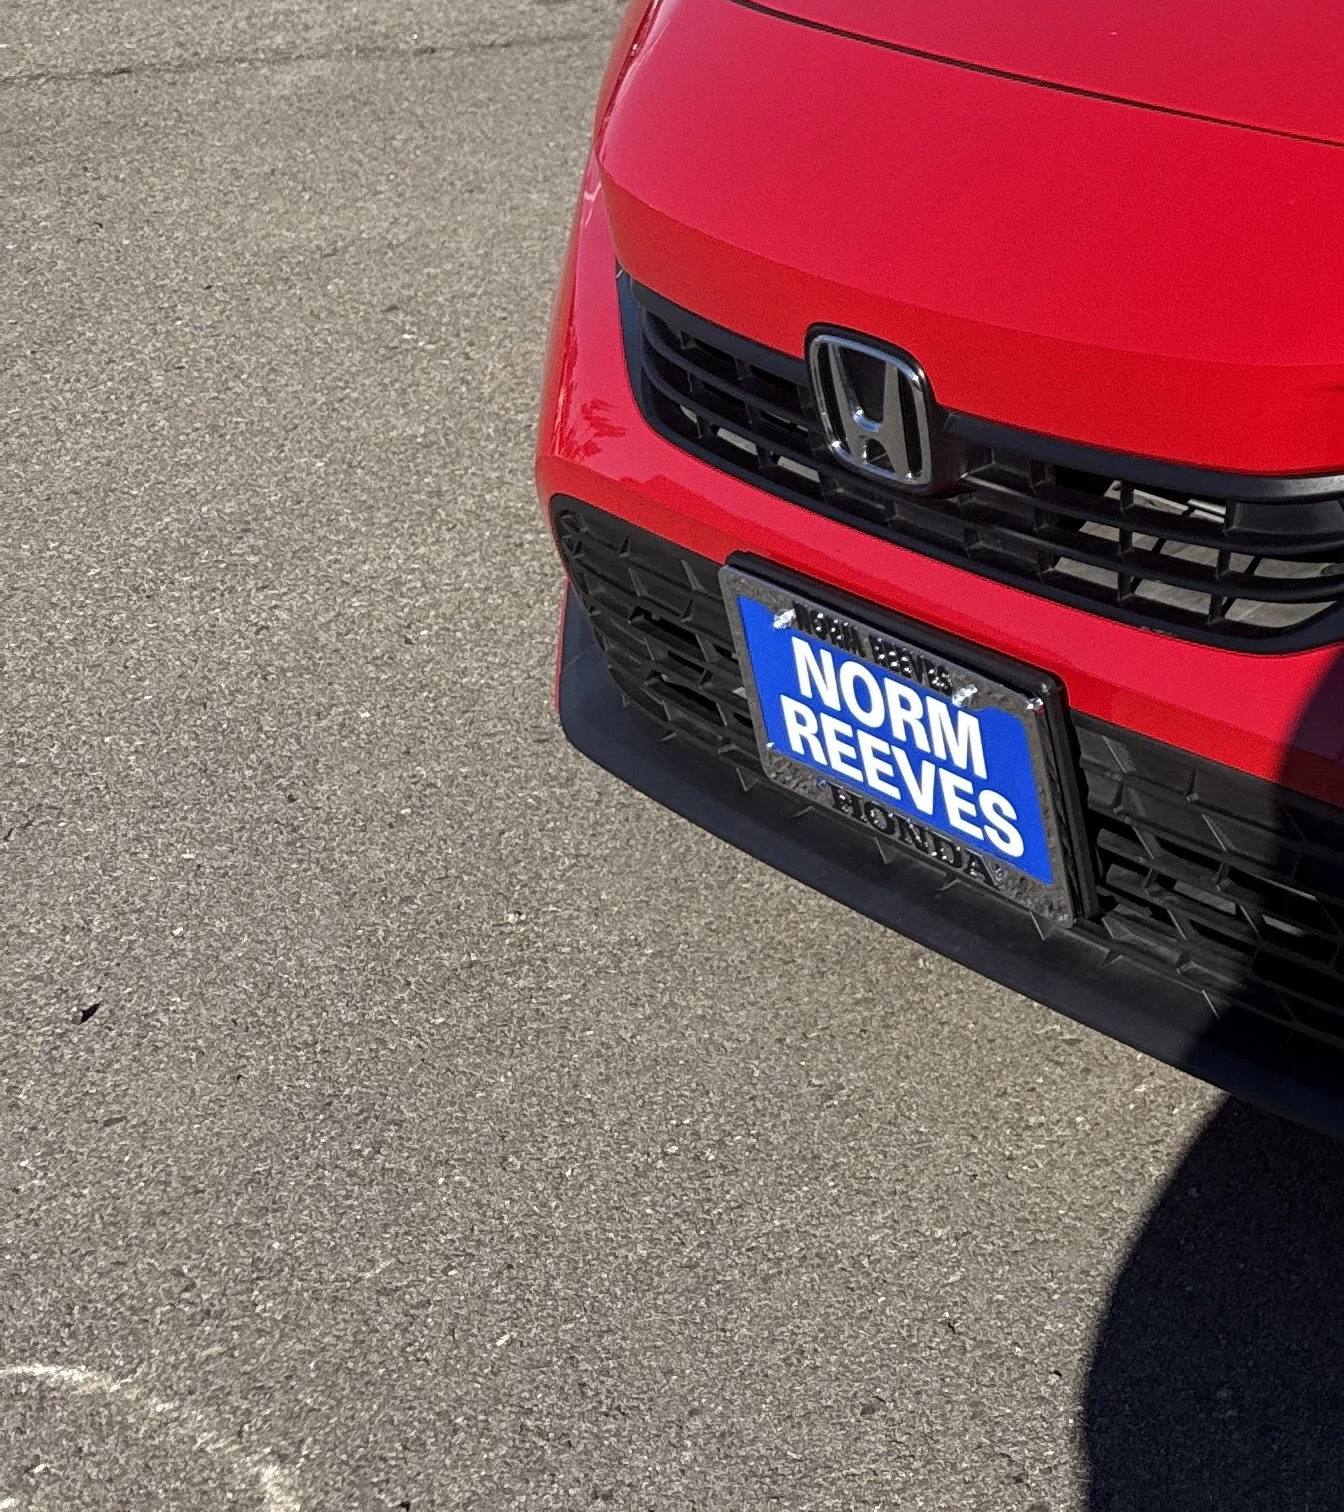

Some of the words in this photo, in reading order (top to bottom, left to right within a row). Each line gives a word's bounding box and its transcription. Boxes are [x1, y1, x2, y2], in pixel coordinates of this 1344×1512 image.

[779, 693, 1025, 858] REEVES
[791, 635, 988, 780] NORM
[829, 783, 1002, 888] HONDA
